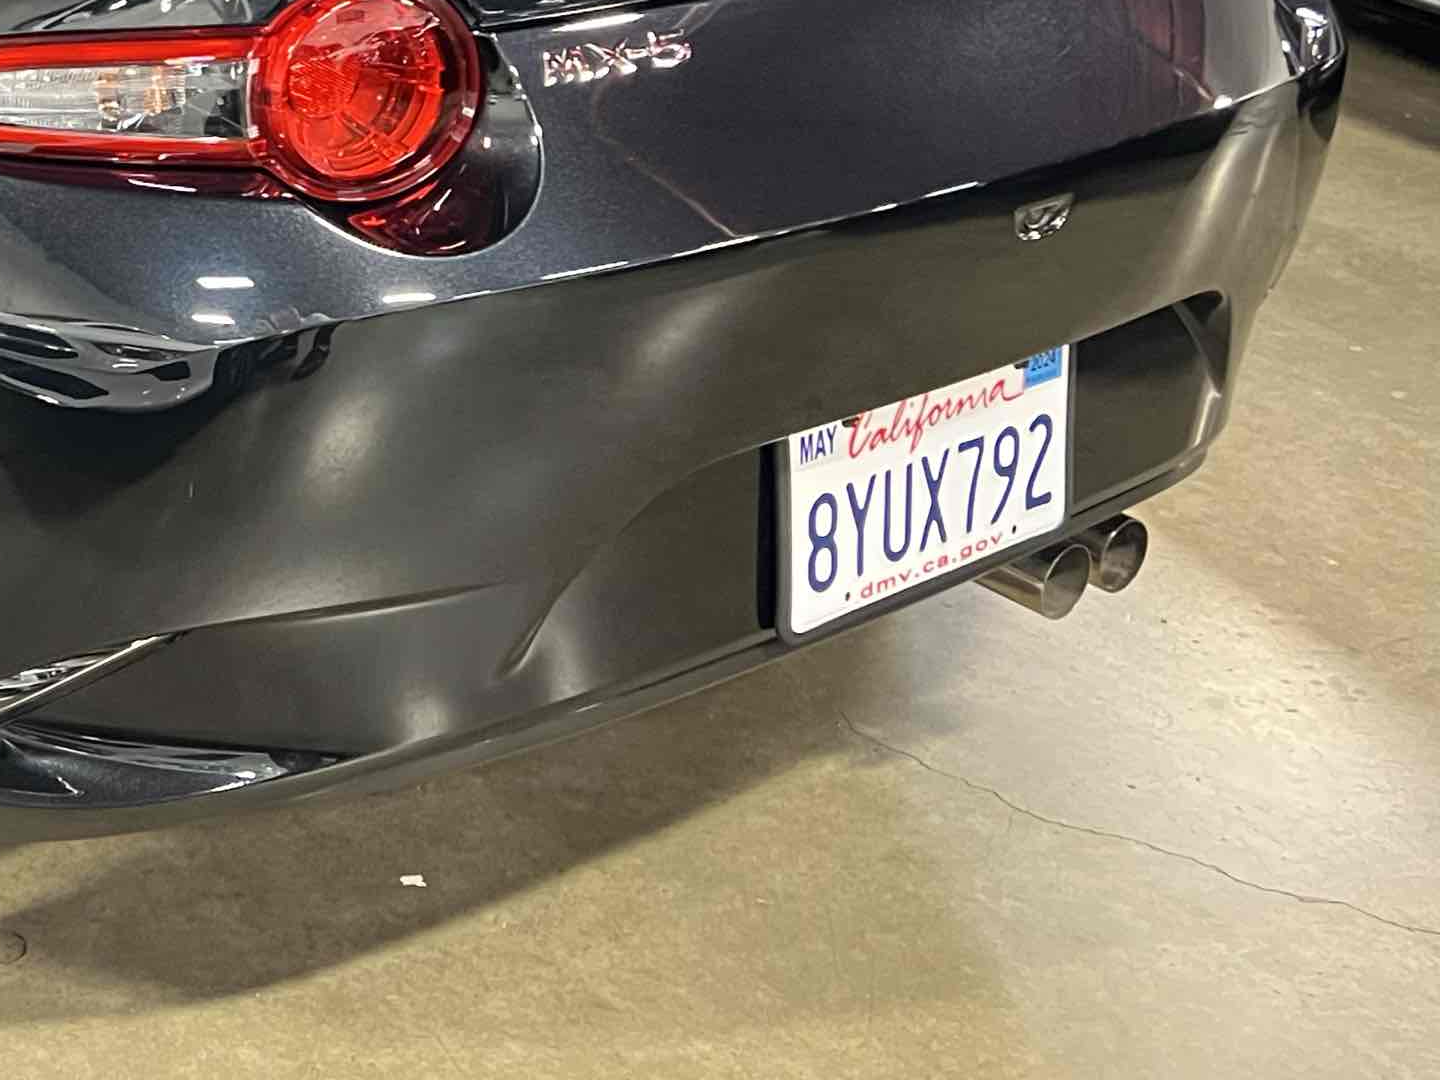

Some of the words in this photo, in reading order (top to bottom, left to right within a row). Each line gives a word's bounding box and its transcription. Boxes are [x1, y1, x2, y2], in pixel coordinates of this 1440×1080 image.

[542, 29, 693, 88] MX-5
[799, 424, 838, 466] MAY
[847, 377, 1024, 460] California
[807, 413, 1054, 593] 8YUX792
[860, 533, 1005, 600] dmv.ca.gov
